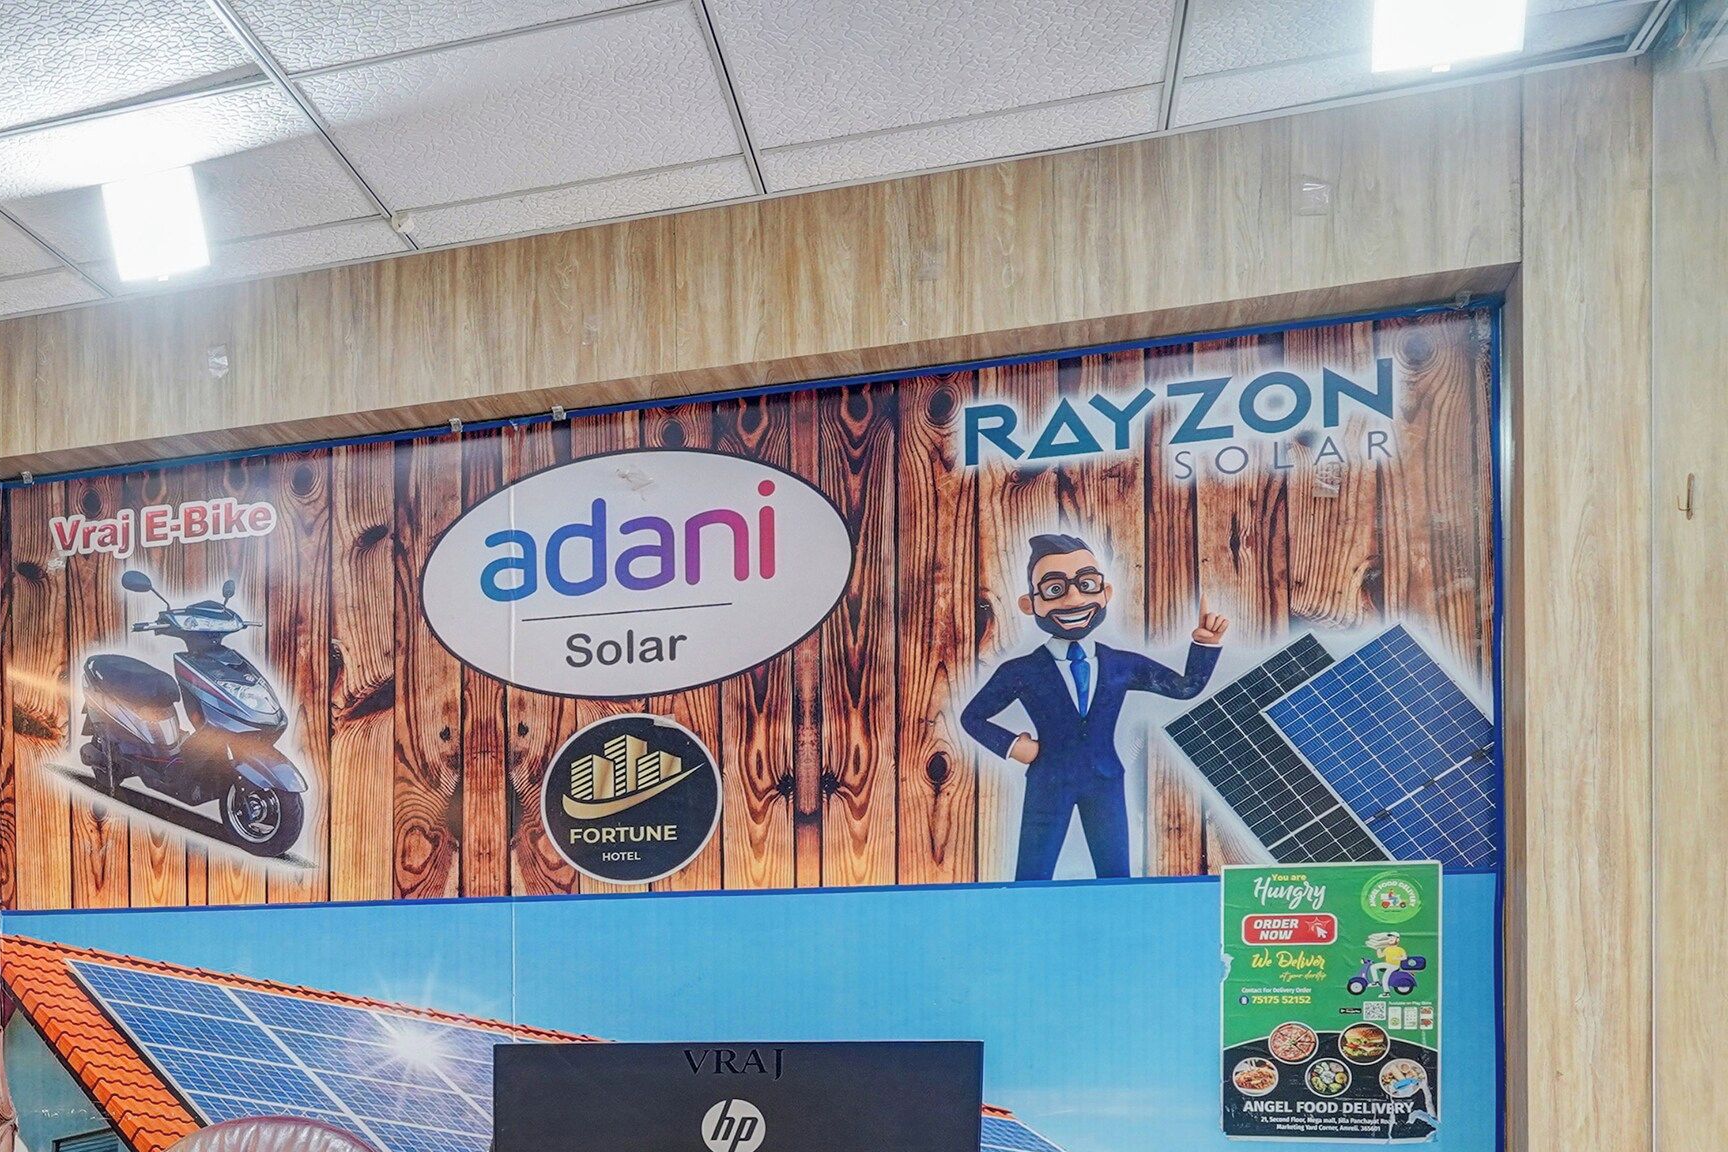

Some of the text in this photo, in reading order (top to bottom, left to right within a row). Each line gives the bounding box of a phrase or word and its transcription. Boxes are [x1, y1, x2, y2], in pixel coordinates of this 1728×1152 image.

[964, 358, 1394, 467] RAYZON
[1174, 431, 1393, 480] SOLAR
[52, 501, 274, 556] Vraj E-Bike
[479, 480, 776, 602] adani
[565, 629, 688, 668] Solar
[569, 825, 678, 844] FORTUNE
[602, 852, 641, 862] HOTEL
[1271, 873, 1307, 882] You are
[1253, 877, 1327, 910] Hungry
[1253, 918, 1299, 930] ORDER
[1259, 930, 1294, 941] NOW
[1251, 947, 1325, 970] We Deliver
[1251, 995, 1311, 1004] 75175 52152
[683, 1048, 785, 1081] VRAJ
[1243, 1101, 1414, 1115] ANGEL FOOD DELIVERY
